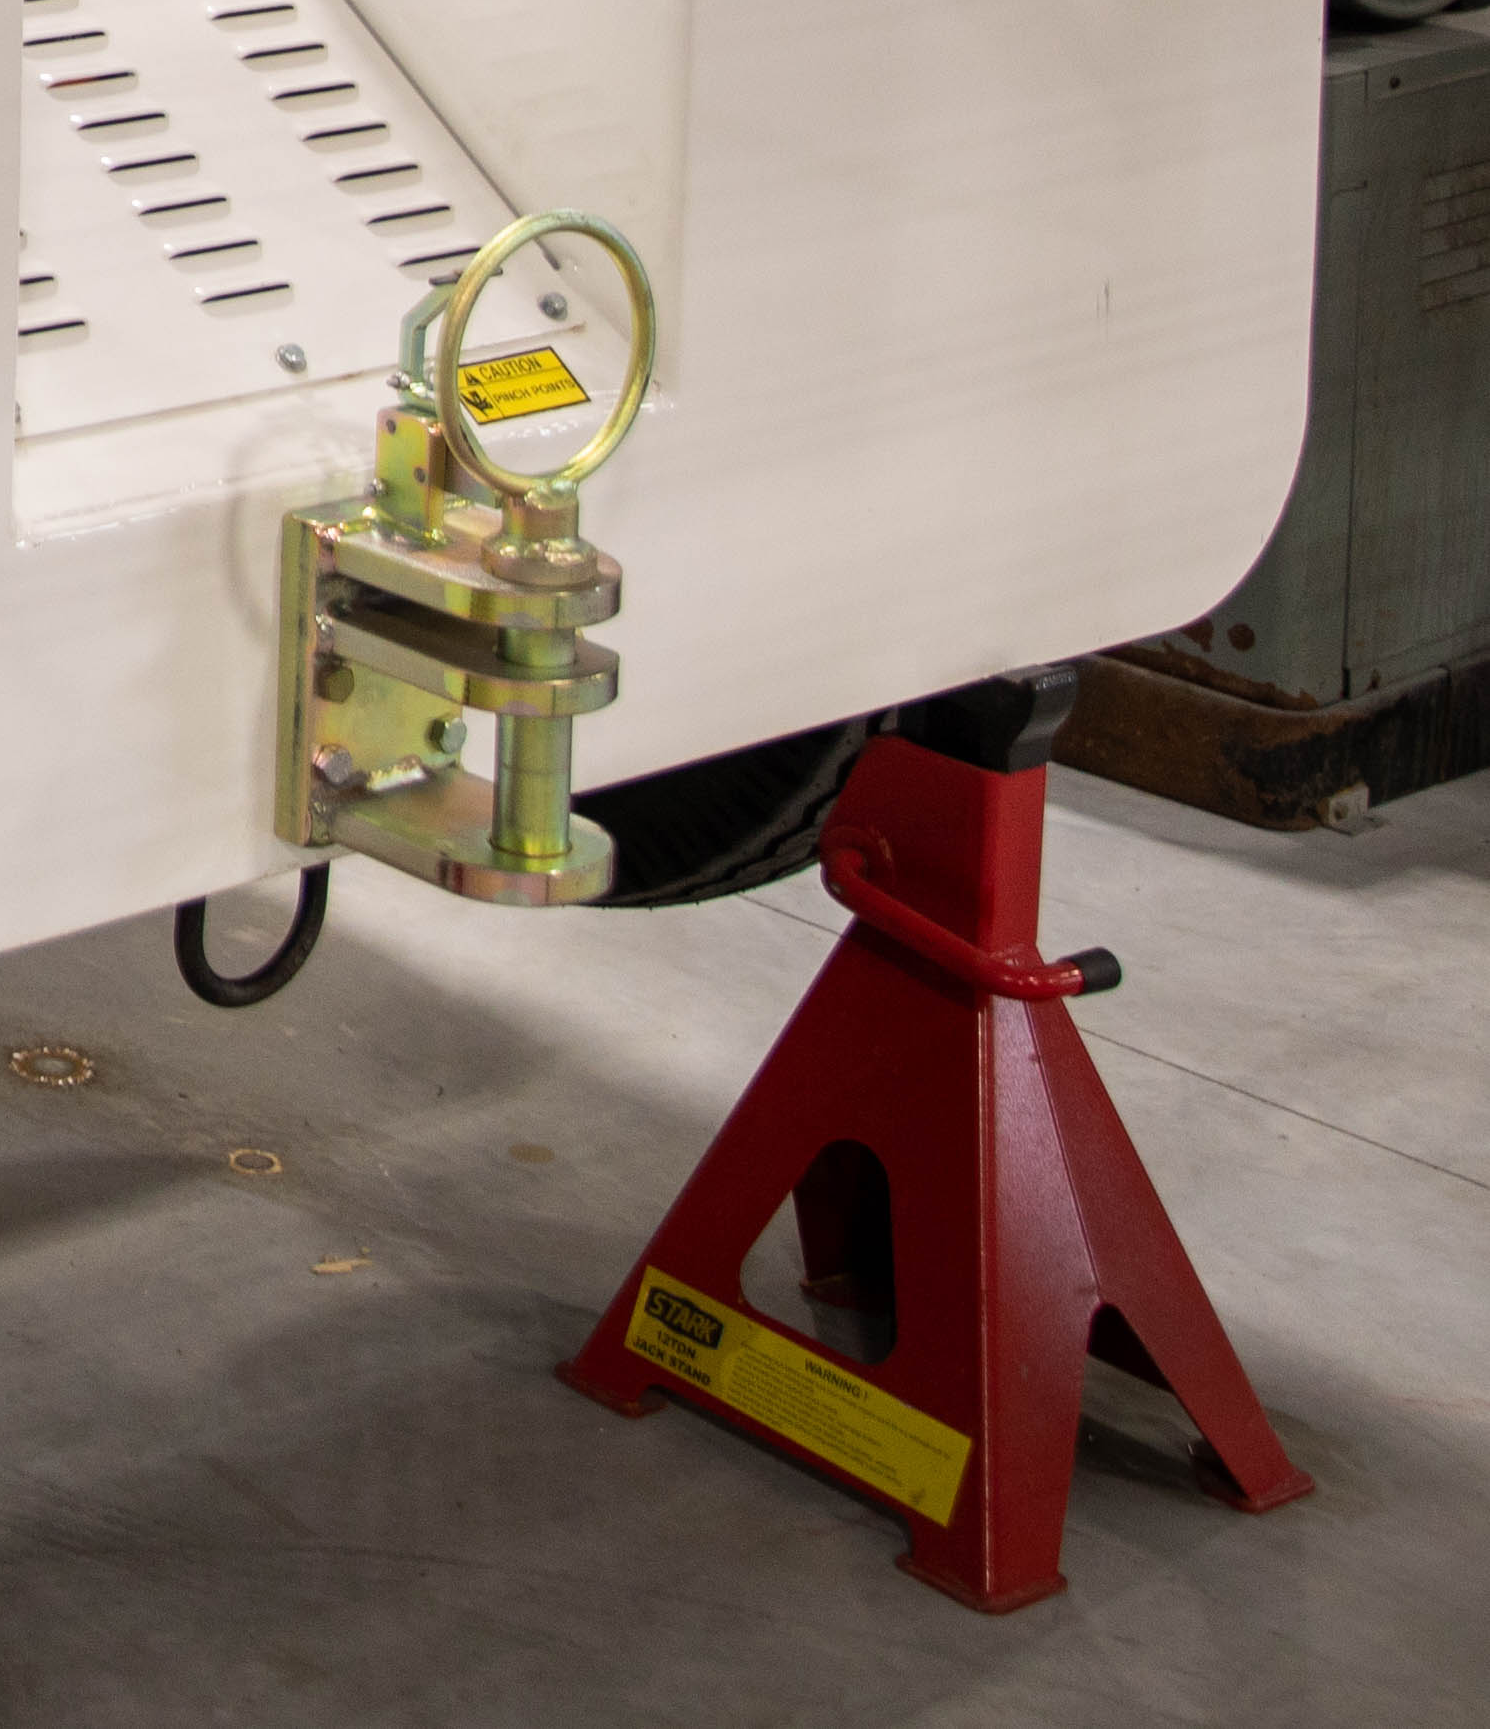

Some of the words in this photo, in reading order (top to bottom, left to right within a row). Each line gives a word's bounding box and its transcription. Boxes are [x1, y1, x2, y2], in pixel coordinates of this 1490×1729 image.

[479, 355, 542, 380] CAUTION
[493, 387, 531, 403] PINCH
[532, 379, 576, 394] POINTS
[647, 1291, 718, 1344] STARK
[633, 1336, 665, 1361] JACK
[669, 1356, 711, 1386] STAND
[804, 1357, 861, 1399] WARNING
